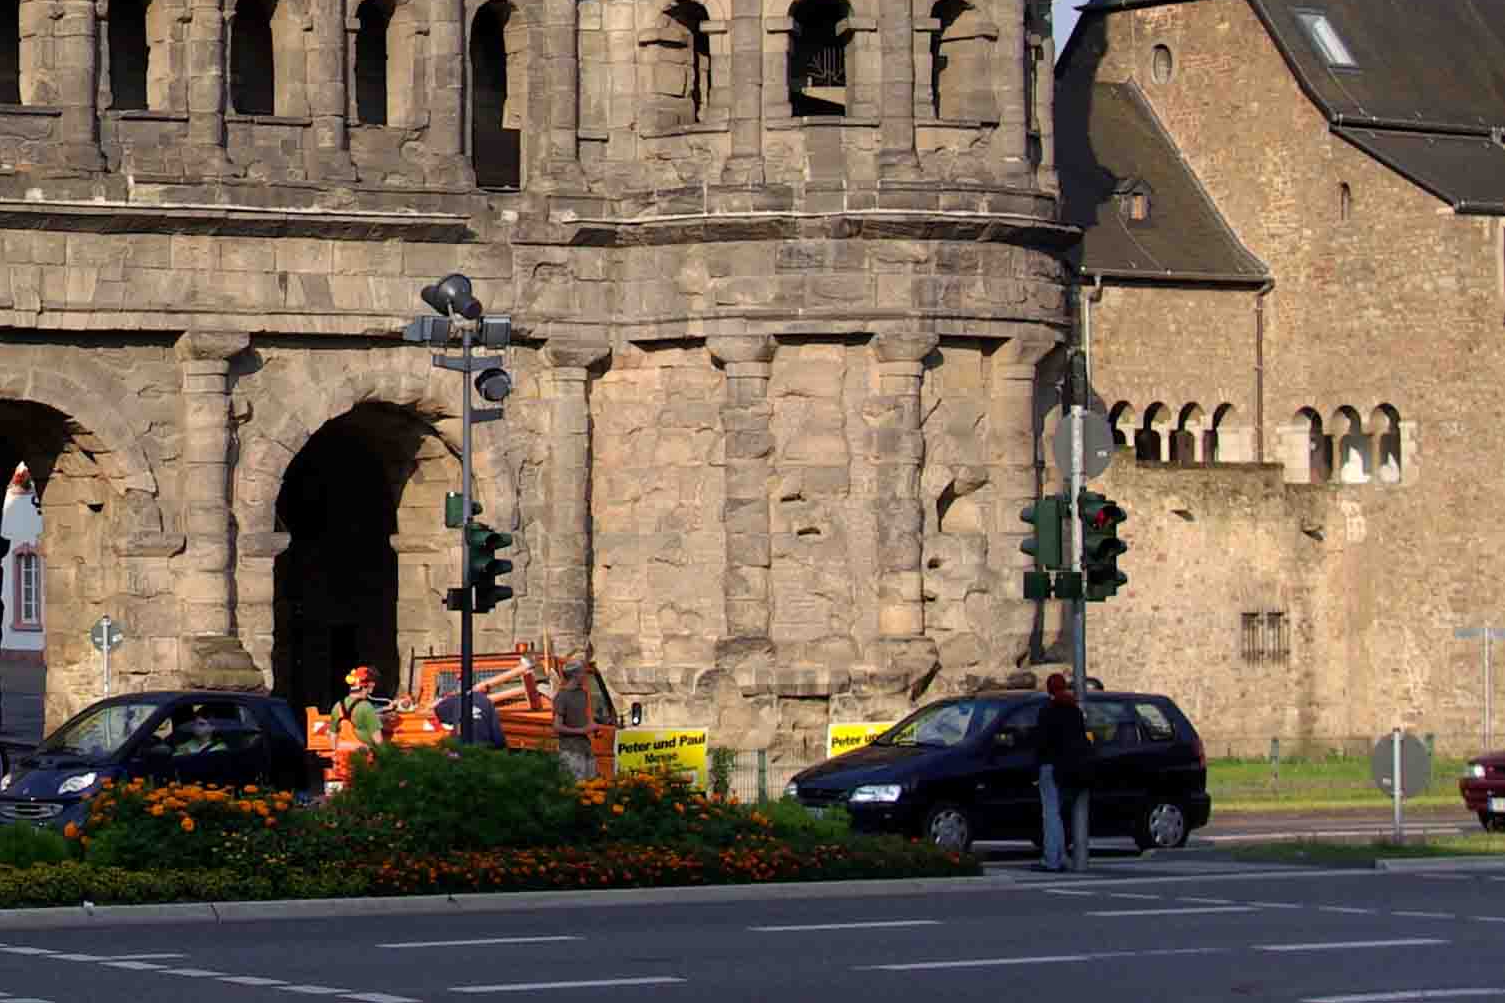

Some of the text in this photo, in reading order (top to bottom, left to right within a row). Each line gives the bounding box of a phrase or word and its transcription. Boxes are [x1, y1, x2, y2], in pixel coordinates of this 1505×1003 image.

[617, 733, 706, 755] Peter und Paul
[831, 735, 861, 748] Peter
